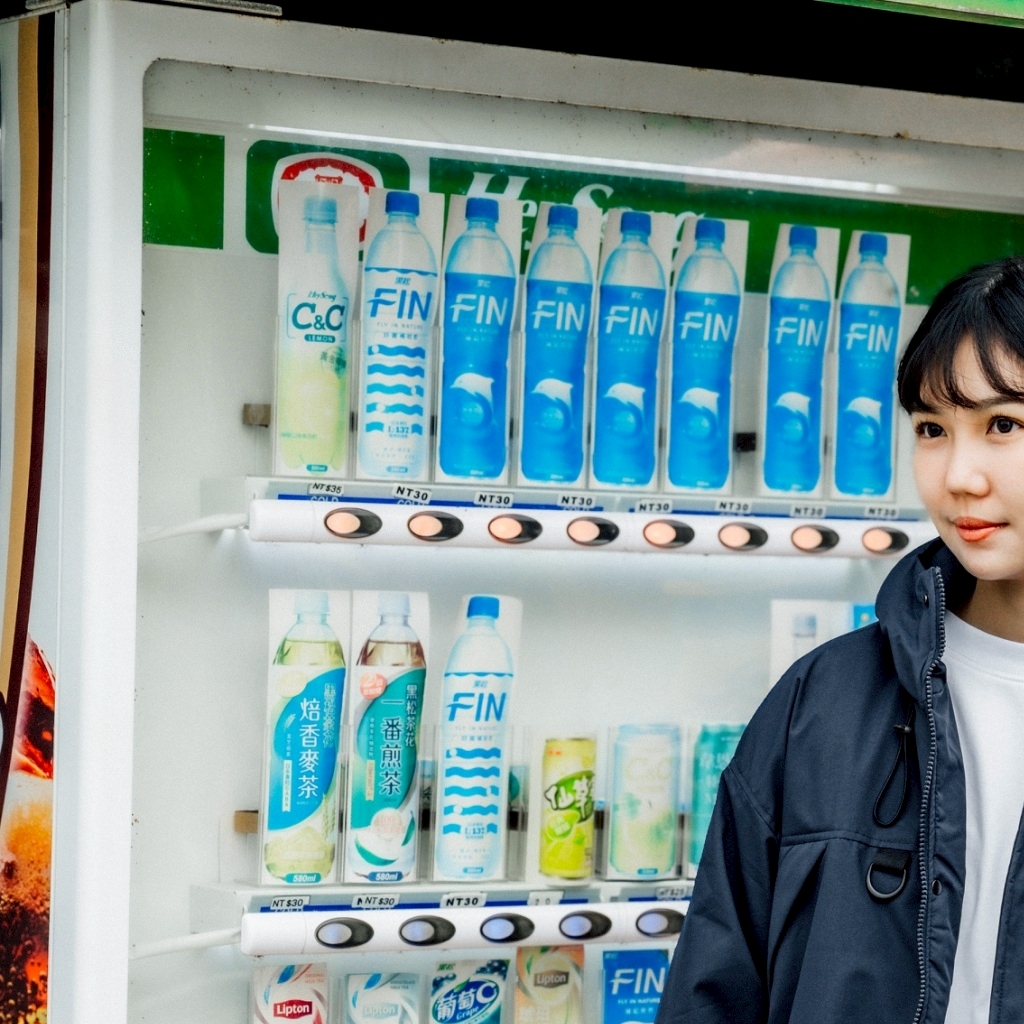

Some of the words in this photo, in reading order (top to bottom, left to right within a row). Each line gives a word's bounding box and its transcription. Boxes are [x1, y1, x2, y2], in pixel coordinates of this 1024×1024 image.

[292, 302, 345, 331] C&C
[367, 288, 432, 321] FIN
[450, 294, 508, 326] FIN
[531, 300, 585, 332] FIN
[604, 306, 658, 336] FIN
[679, 312, 733, 342] FIN
[775, 317, 823, 346] FIN
[846, 323, 894, 352] FIN
[396, 486, 428, 501] NT30
[478, 494, 510, 505] NT30
[561, 496, 593, 507] NT30
[639, 502, 670, 512] NT30
[719, 501, 749, 511] NT30
[447, 693, 507, 722] FIN
[298, 698, 320, 798] 焙香麥茶
[379, 700, 404, 796] 一番煎茶
[446, 897, 479, 907] NT30
[537, 971, 567, 984] Lipton
[610, 967, 666, 996] FIN
[277, 1003, 310, 1016] Lipton
[365, 1006, 396, 1017] Lipton
